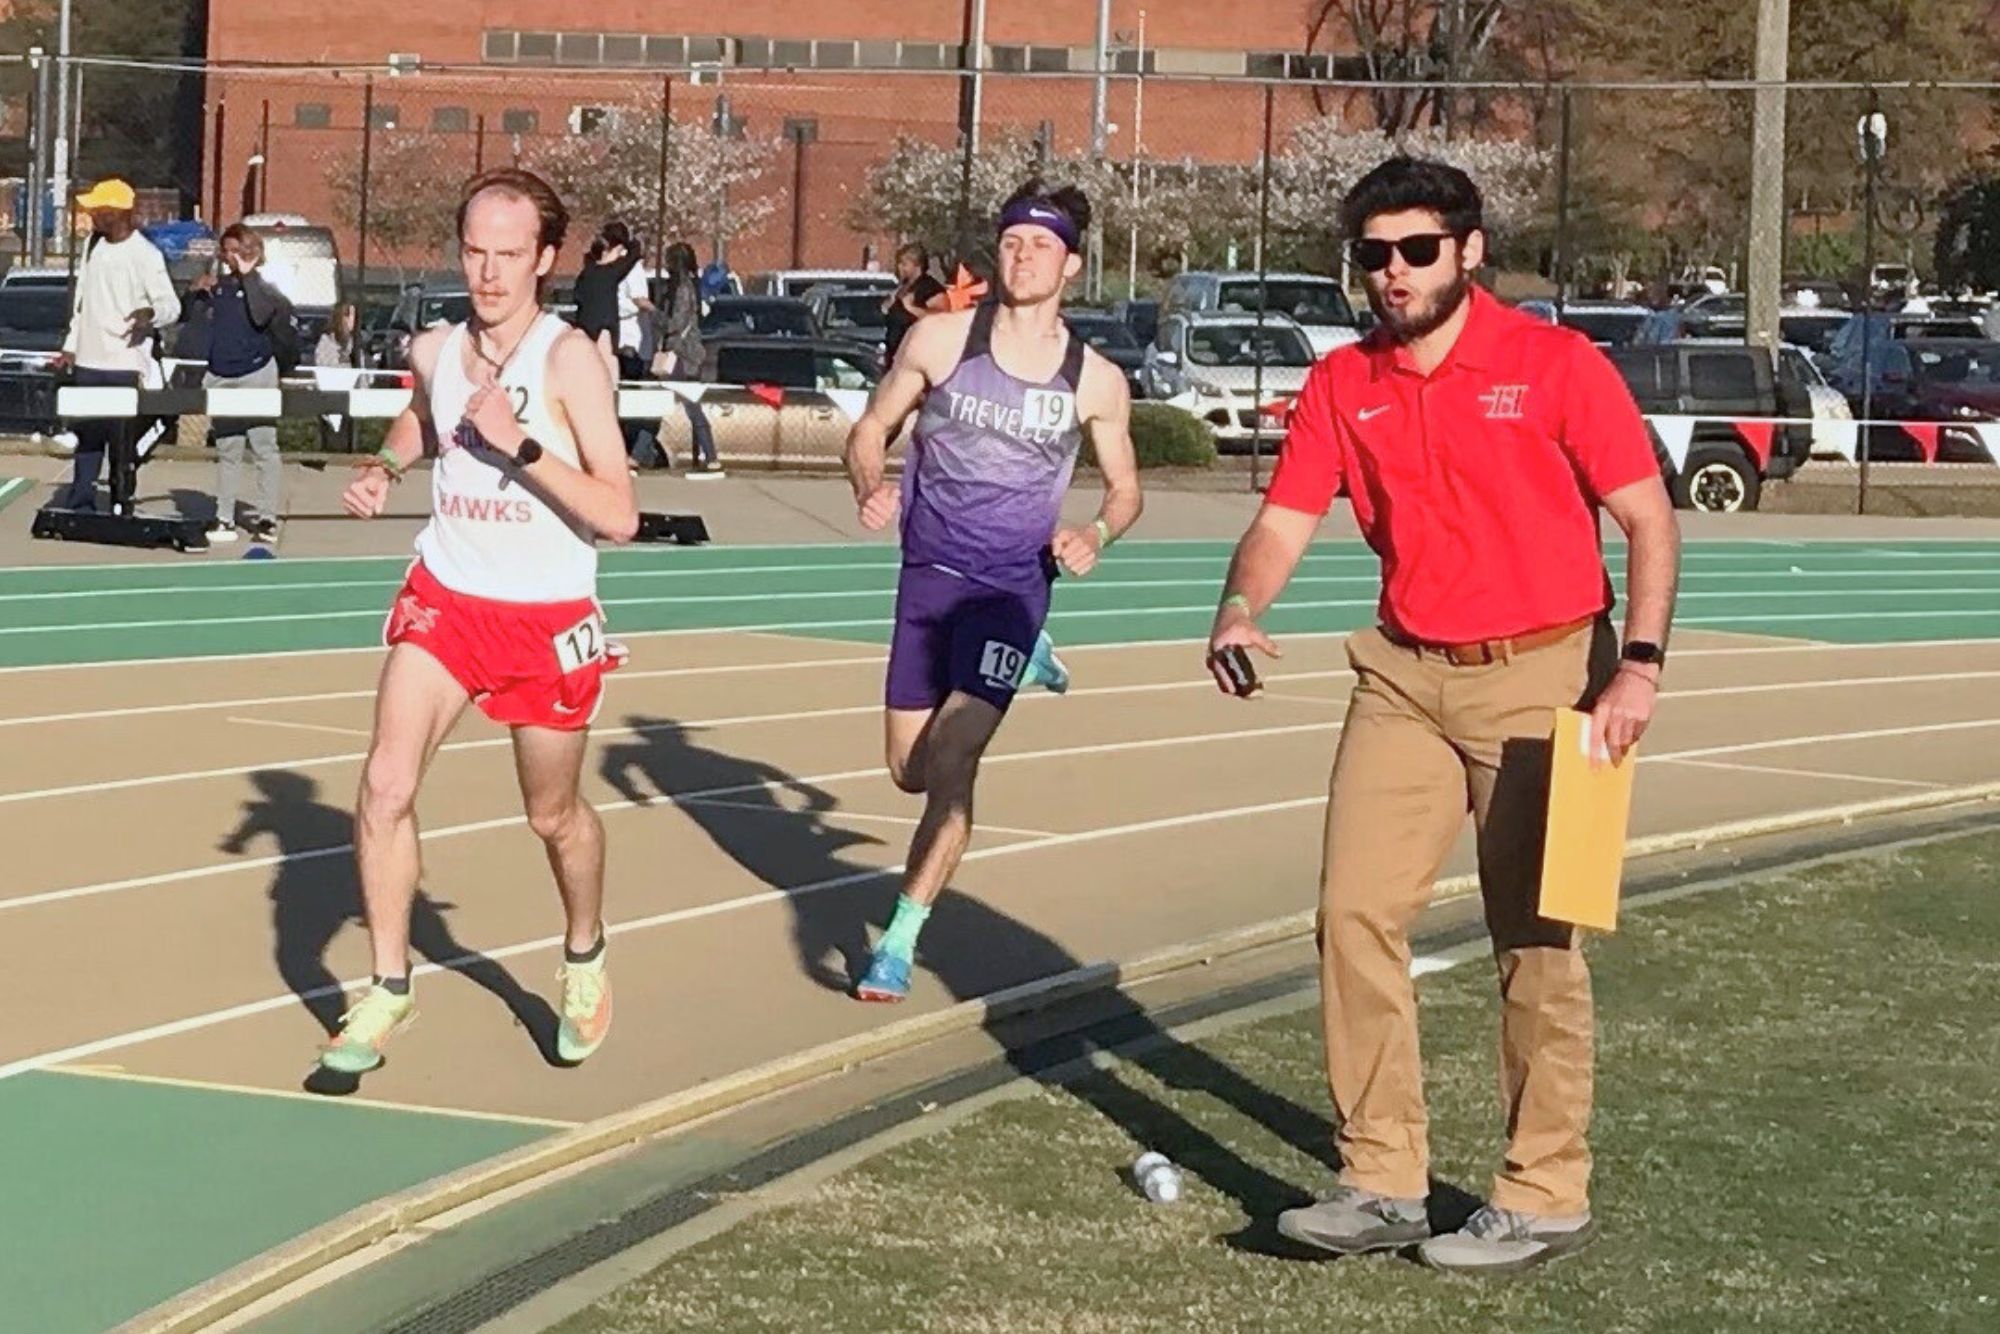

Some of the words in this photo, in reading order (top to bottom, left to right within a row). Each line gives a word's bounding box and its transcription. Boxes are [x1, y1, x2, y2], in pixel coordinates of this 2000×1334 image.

[504, 385, 530, 424] 2
[1035, 393, 1064, 427] 19
[566, 622, 599, 664] 12
[992, 645, 1020, 681] 19
